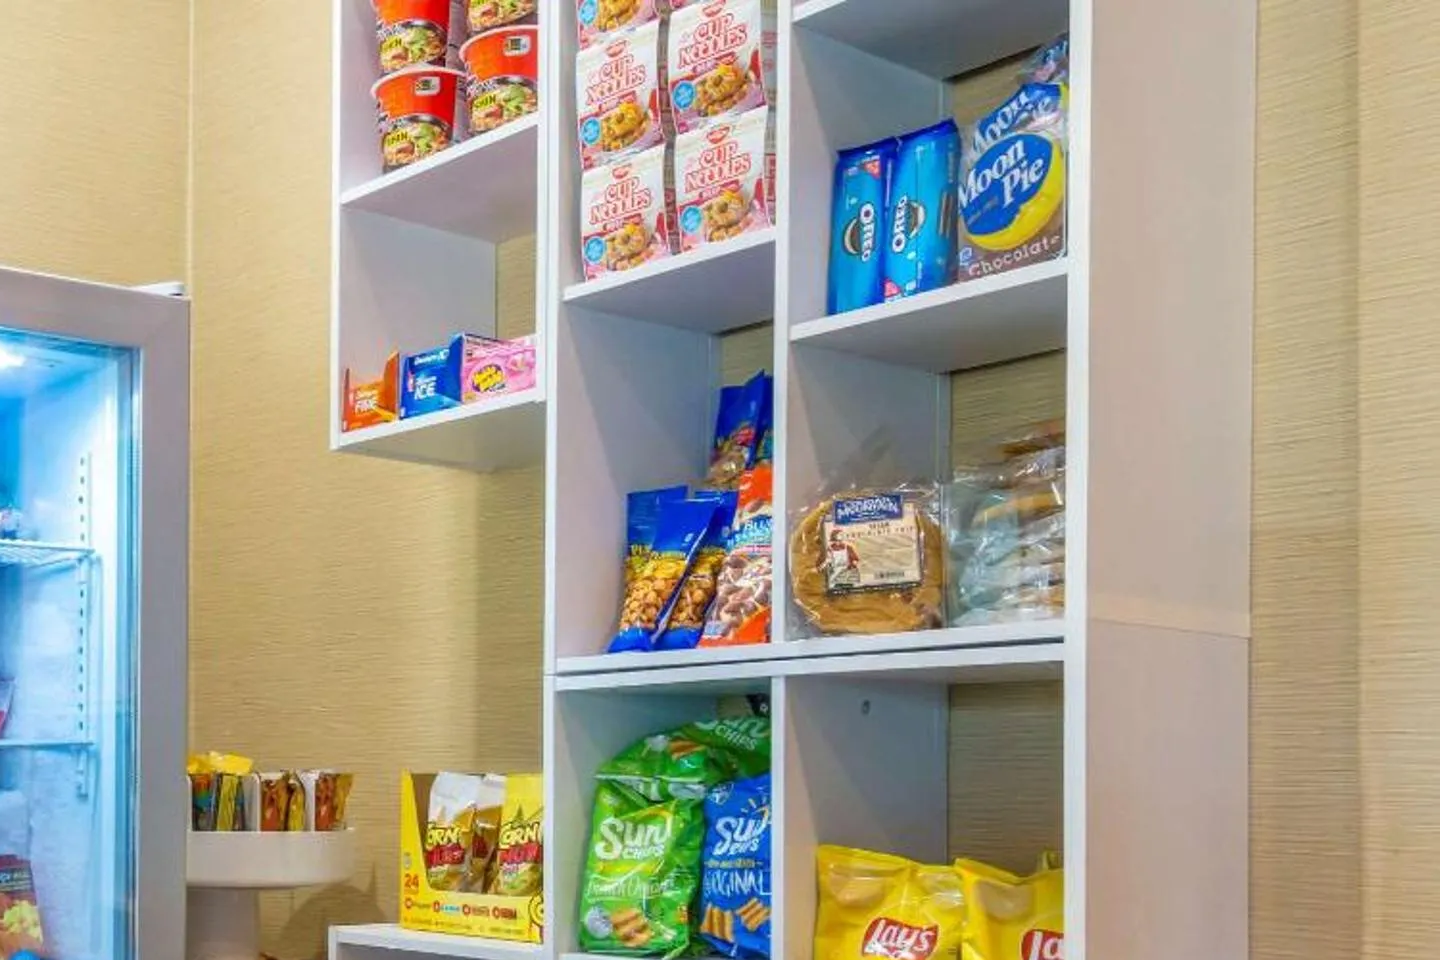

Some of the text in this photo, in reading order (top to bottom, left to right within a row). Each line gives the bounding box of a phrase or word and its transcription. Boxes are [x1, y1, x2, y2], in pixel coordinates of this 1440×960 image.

[1002, 156, 1045, 208] Pie
[594, 816, 672, 861] Sun
[864, 918, 935, 960] Lay's
